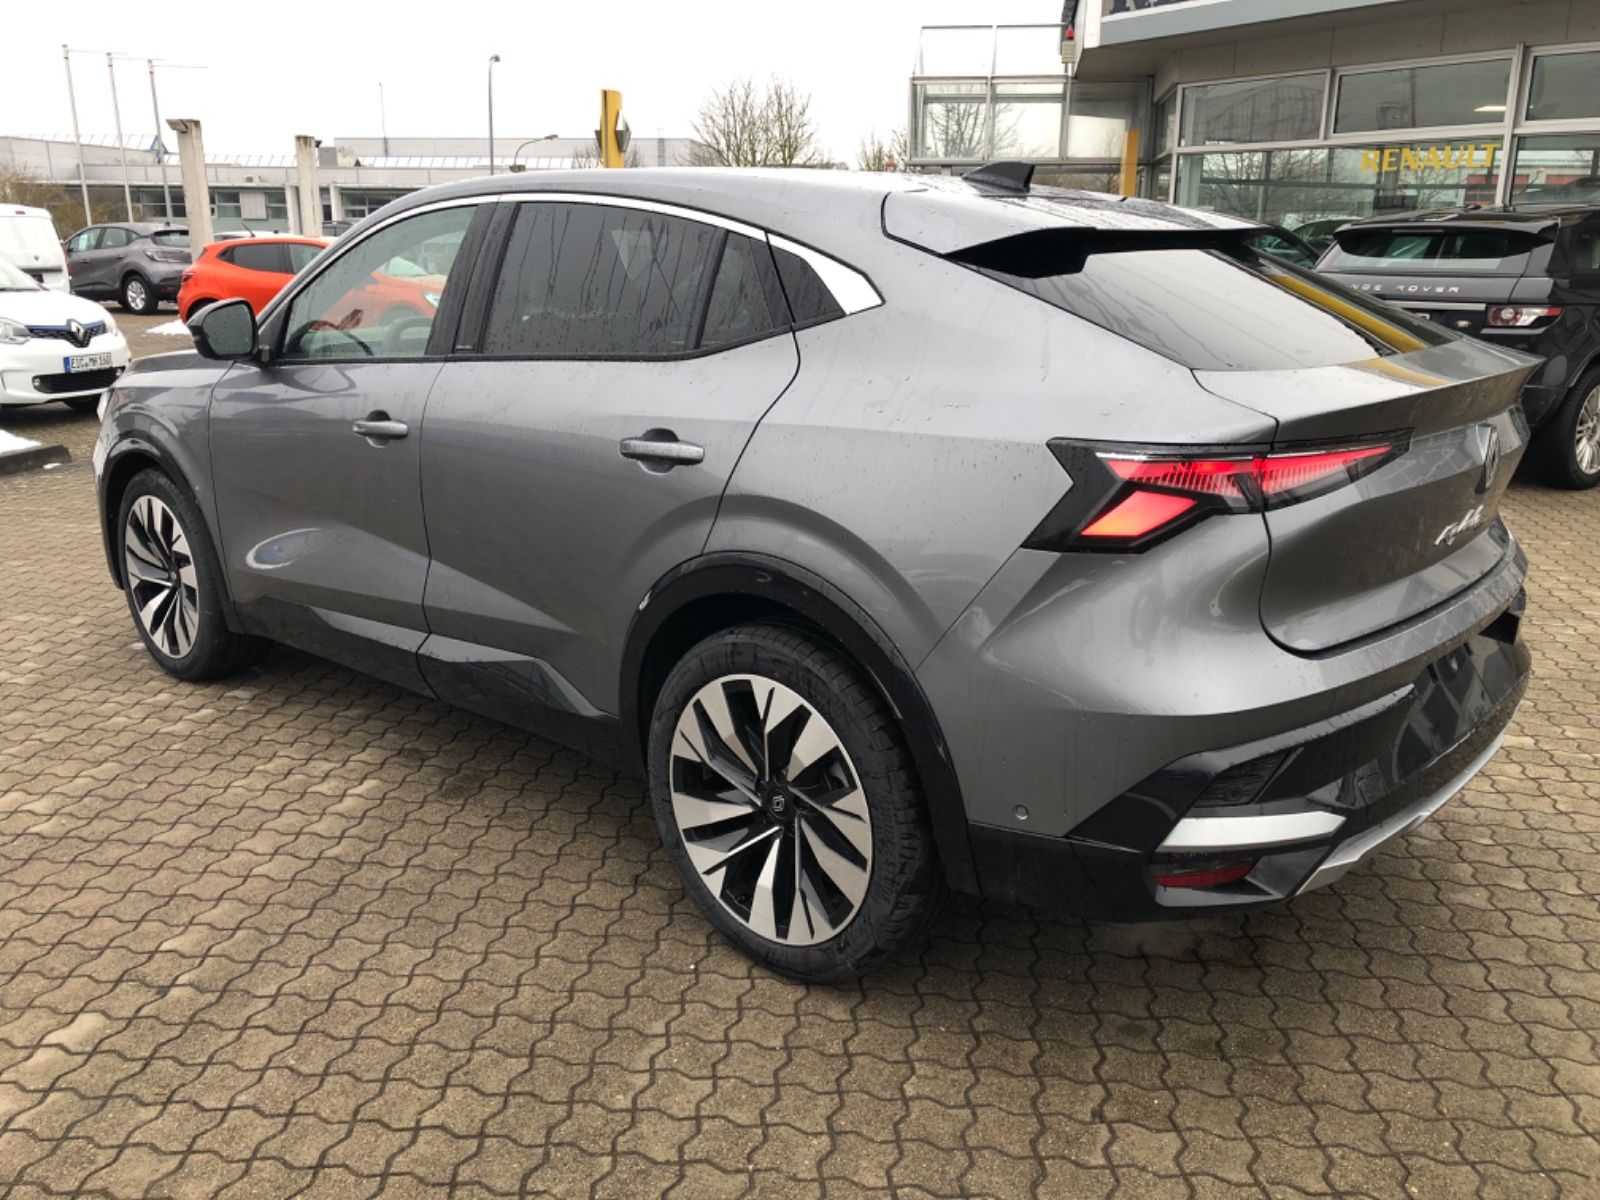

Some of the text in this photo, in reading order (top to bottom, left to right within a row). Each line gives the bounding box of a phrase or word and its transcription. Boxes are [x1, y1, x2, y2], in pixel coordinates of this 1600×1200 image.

[1361, 143, 1500, 173] RENAULT
[1350, 283, 1460, 293] NGE ROVER
